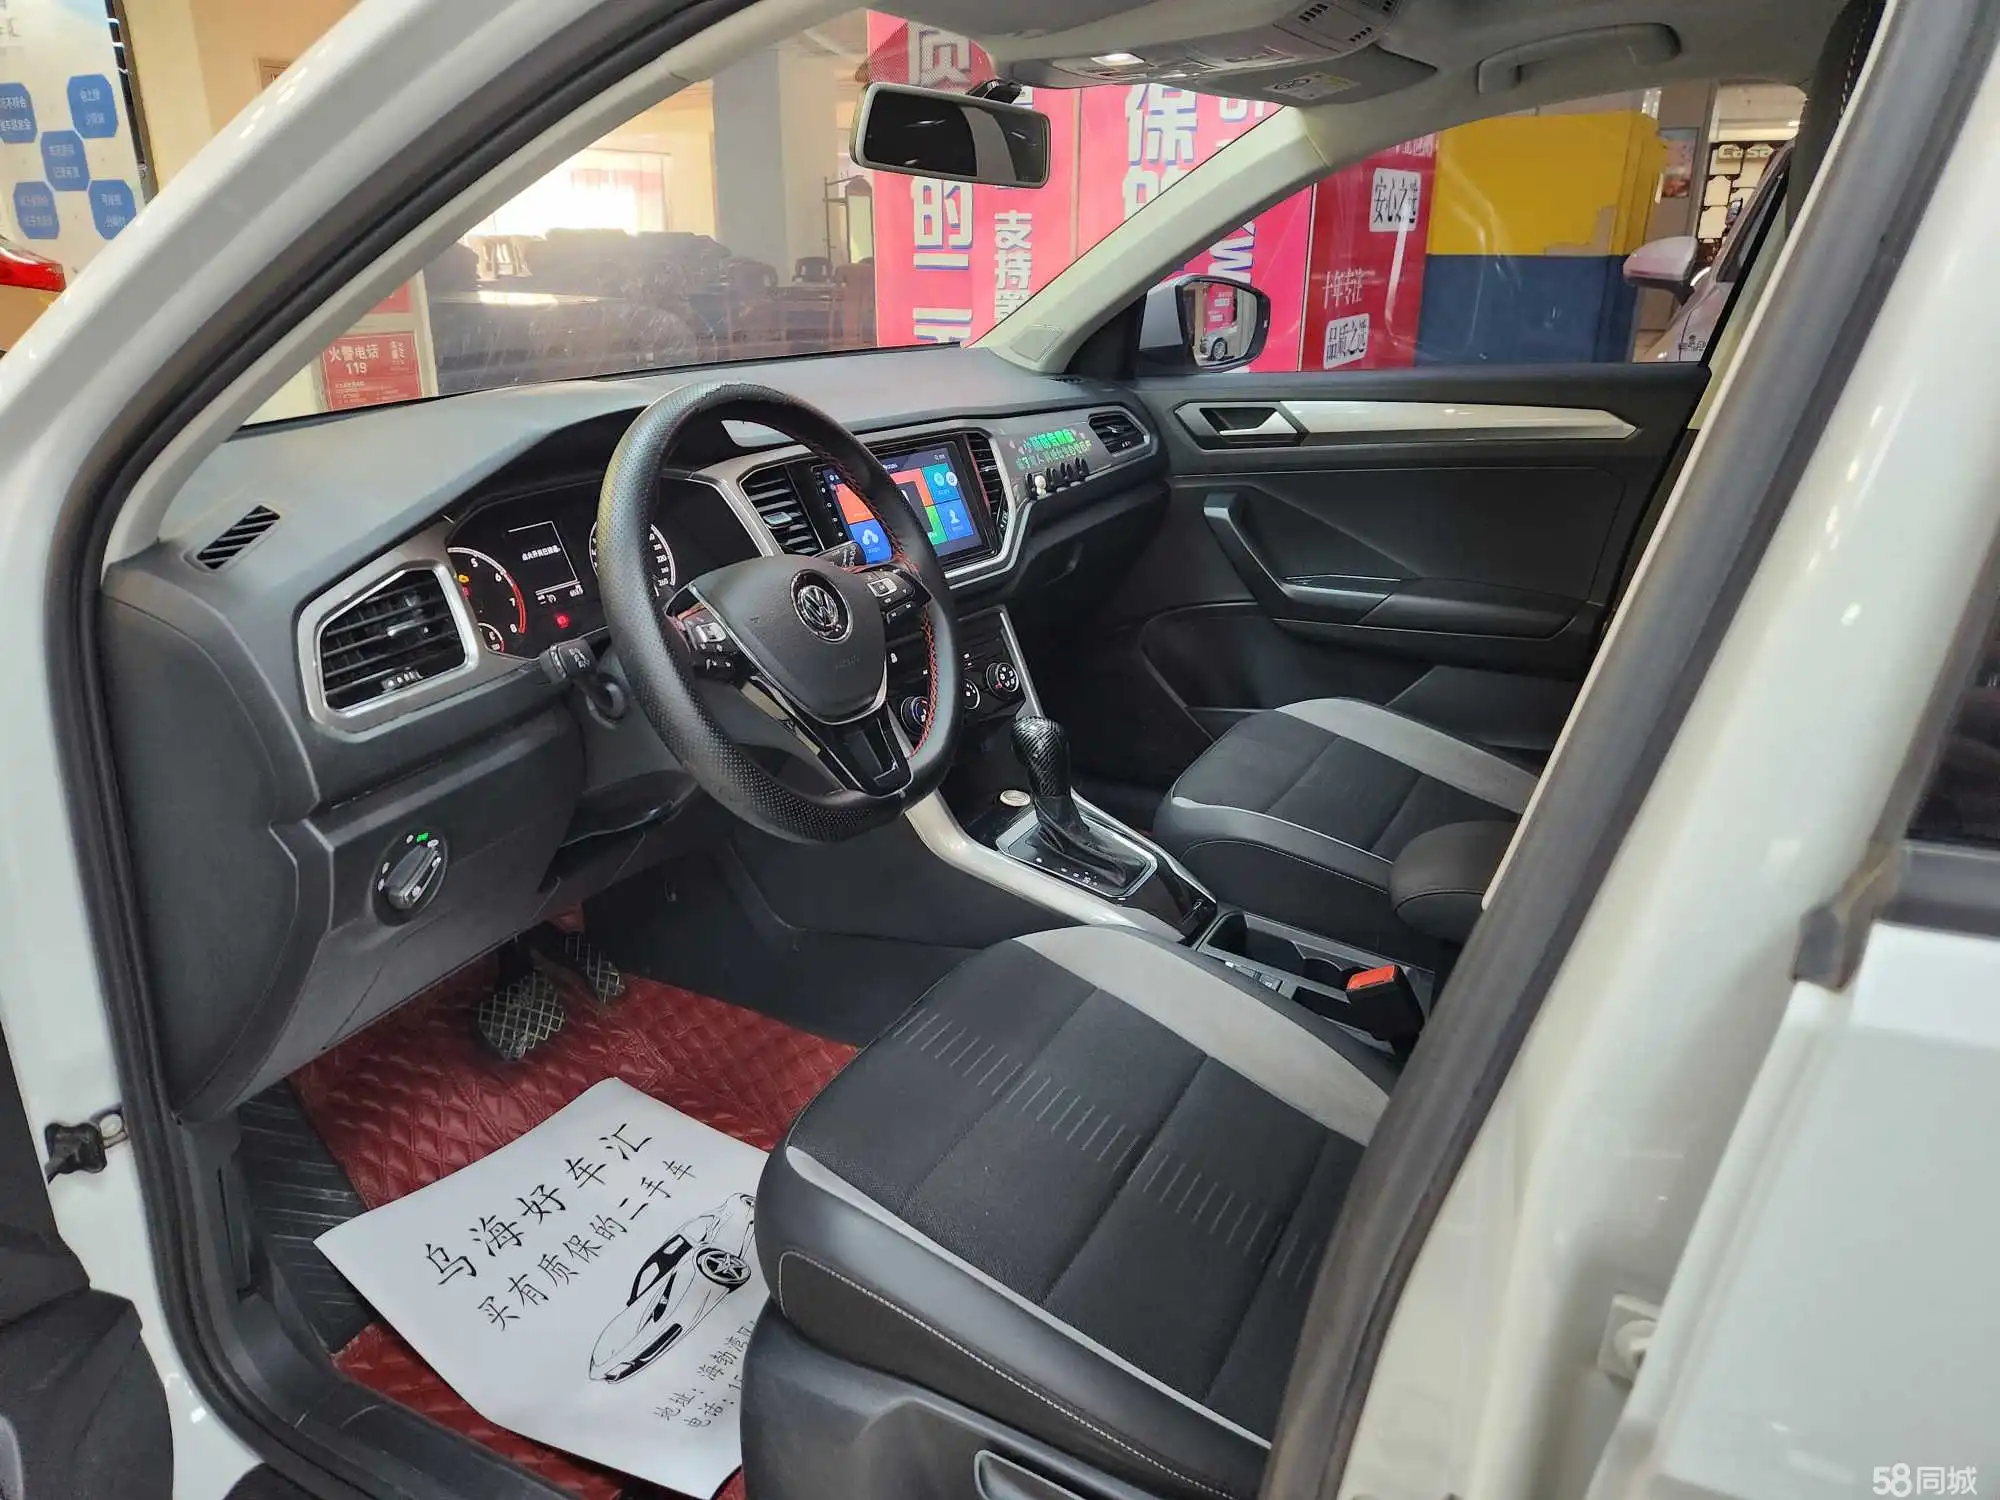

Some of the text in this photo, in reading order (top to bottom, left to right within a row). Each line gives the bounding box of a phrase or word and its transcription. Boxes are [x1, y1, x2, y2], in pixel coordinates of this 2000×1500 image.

[328, 344, 380, 363] 火警电话
[345, 361, 368, 375] 119
[424, 1122, 653, 1286] 乌海好车汇
[477, 1158, 697, 1331] 买有质保的二手车
